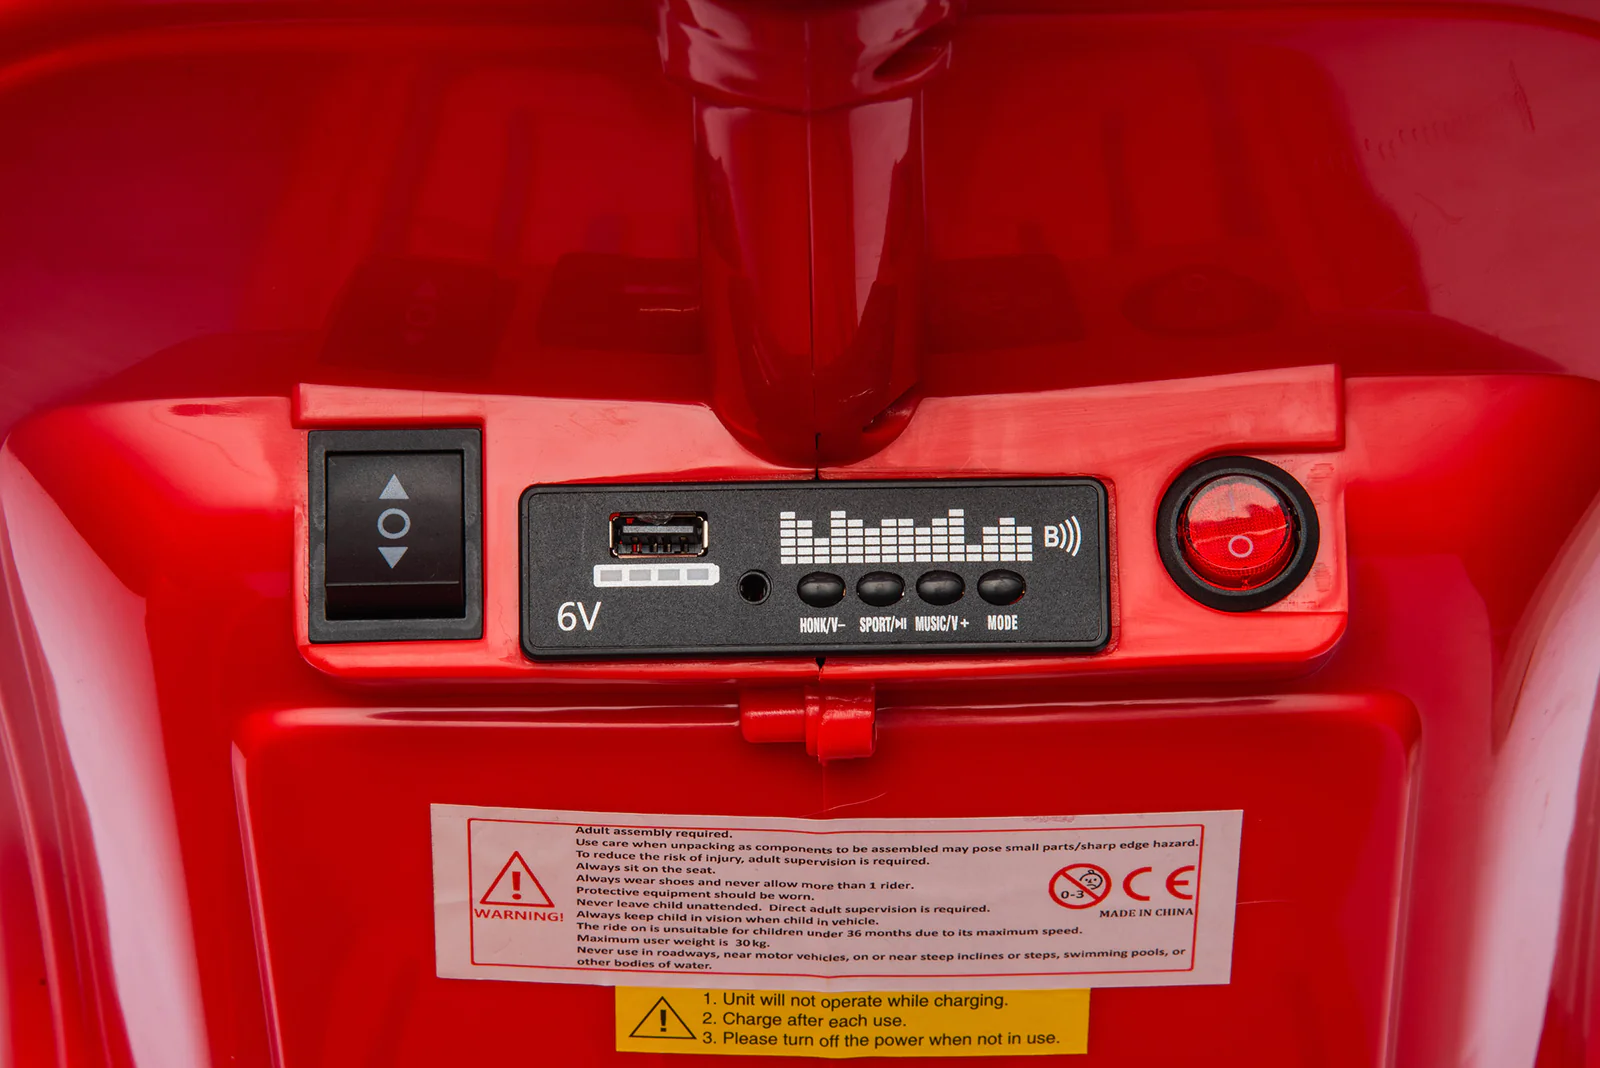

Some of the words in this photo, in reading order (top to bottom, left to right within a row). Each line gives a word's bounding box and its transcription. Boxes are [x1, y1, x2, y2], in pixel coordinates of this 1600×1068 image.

[557, 601, 602, 631] 6V
[987, 614, 1018, 631] MODE
[574, 825, 610, 835] Adult
[613, 827, 673, 839] assembly
[675, 829, 733, 840] required.
[575, 837, 599, 847] Use
[601, 840, 629, 848] care
[631, 839, 667, 849] when
[670, 841, 735, 852] unpacking
[737, 843, 752, 851] as
[754, 844, 833, 855] components
[835, 845, 849, 854] to
[852, 844, 868, 853] be
[870, 844, 939, 854] assembled
[941, 845, 969, 855] may
[971, 845, 1002, 854] pose
[1004, 842, 1039, 852] small
[1042, 841, 1116, 853] parts/sharp
[1119, 840, 1150, 851] edge
[1152, 838, 1199, 848] hazard.
[575, 849, 590, 859] To
[593, 850, 636, 860] reduce
[639, 851, 660, 861] the
[663, 852, 686, 862] risk
[688, 853, 703, 862] of
[705, 853, 745, 865] injury,
[747, 854, 781, 864] adult
[783, 856, 856, 867] supervision
[859, 856, 870, 866] is
[872, 856, 930, 867] required.
[575, 861, 621, 873] Always
[623, 863, 639, 873] sit
[641, 865, 659, 873] on
[661, 864, 683, 874] the
[685, 866, 716, 875] seat.
[575, 873, 621, 885] Always
[623, 877, 656, 885] wear
[658, 876, 695, 886] shoes
[697, 877, 721, 887] and
[724, 879, 760, 888] never
[763, 878, 798, 888] allow
[801, 881, 834, 891] more
[836, 880, 866, 890] than
[869, 881, 876, 890] 1
[880, 880, 914, 890] rider.
[1123, 865, 1195, 901] CE
[576, 885, 640, 897] Protective
[642, 888, 711, 899] equipment
[714, 890, 756, 899] should
[759, 890, 775, 900] be
[777, 893, 815, 901] worn.
[1060, 890, 1084, 899] 0-3
[474, 908, 564, 922] WARNING!
[576, 897, 614, 907] Never
[616, 898, 650, 909] leave
[652, 900, 683, 910] child
[686, 902, 762, 912] unattended.
[768, 903, 806, 913] Direct
[809, 905, 842, 915] adult
[844, 904, 917, 915] supervision
[919, 904, 930, 913] is
[933, 903, 990, 915] required.
[1099, 909, 1136, 918] MADE
[1139, 909, 1152, 917] IN
[1155, 908, 1194, 916] CHINA
[576, 909, 621, 921] Always
[623, 911, 654, 922] keep
[656, 912, 687, 922] child
[690, 913, 703, 922] in
[704, 914, 742, 923] vision
[745, 914, 780, 924] when
[783, 915, 814, 925] child
[816, 917, 829, 927] in
[831, 916, 879, 926] vehicle.
[575, 921, 600, 931] The
[602, 922, 628, 932] ride
[649, 924, 660, 933] is
[662, 925, 729, 935] unsuitable
[731, 925, 750, 935] for
[752, 926, 804, 936] children
[806, 929, 844, 939] under
[846, 929, 862, 938] 36
[864, 928, 912, 937] months
[914, 928, 939, 937] due
[941, 929, 955, 937] to
[957, 928, 973, 937] its
[975, 927, 1039, 937] maximum
[1041, 926, 1083, 937] speed.
[576, 933, 640, 944] Maximum
[642, 937, 671, 945] user
[672, 937, 715, 948] weight
[718, 938, 729, 947] is
[576, 945, 614, 955] Never
[616, 948, 639, 956] use
[641, 947, 653, 956] in
[656, 948, 720, 960] roadways,
[723, 951, 752, 959] near
[754, 951, 794, 960] motor
[796, 952, 850, 962] vehicles,
[852, 953, 869, 961] on
[871, 953, 886, 961] or
[888, 953, 918, 961] near
[920, 952, 954, 963] steep
[956, 951, 1004, 961] inclines
[1007, 952, 1021, 960] or
[1023, 951, 1060, 961] steps,
[1063, 949, 1128, 959] swimming
[1130, 947, 1168, 958] pools,
[1171, 948, 1186, 956] or
[576, 957, 611, 966] other
[614, 958, 655, 968] bodies
[657, 959, 671, 969] of
[673, 961, 712, 970] water.
[703, 992, 716, 1005] 1.
[723, 992, 755, 1006] Unit
[760, 993, 785, 1006] will
[791, 995, 816, 1007] not
[820, 994, 882, 1011] operate
[887, 994, 929, 1007] while
[934, 993, 1009, 1010] charging.
[702, 1011, 717, 1025] 2.
[722, 1011, 782, 1029] Charge
[787, 1013, 824, 1027] after
[828, 1014, 867, 1028] each
[873, 1016, 907, 1027] use.
[702, 1031, 717, 1044] 3.
[723, 1031, 778, 1045] Please
[783, 1033, 814, 1046] turn
[819, 1034, 840, 1048] off
[844, 1034, 869, 1047] the
[874, 1035, 924, 1049] power
[929, 1033, 972, 1046] when
[977, 1033, 1003, 1045] not
[1007, 1032, 1021, 1045] in
[1027, 1033, 1060, 1044] use.
